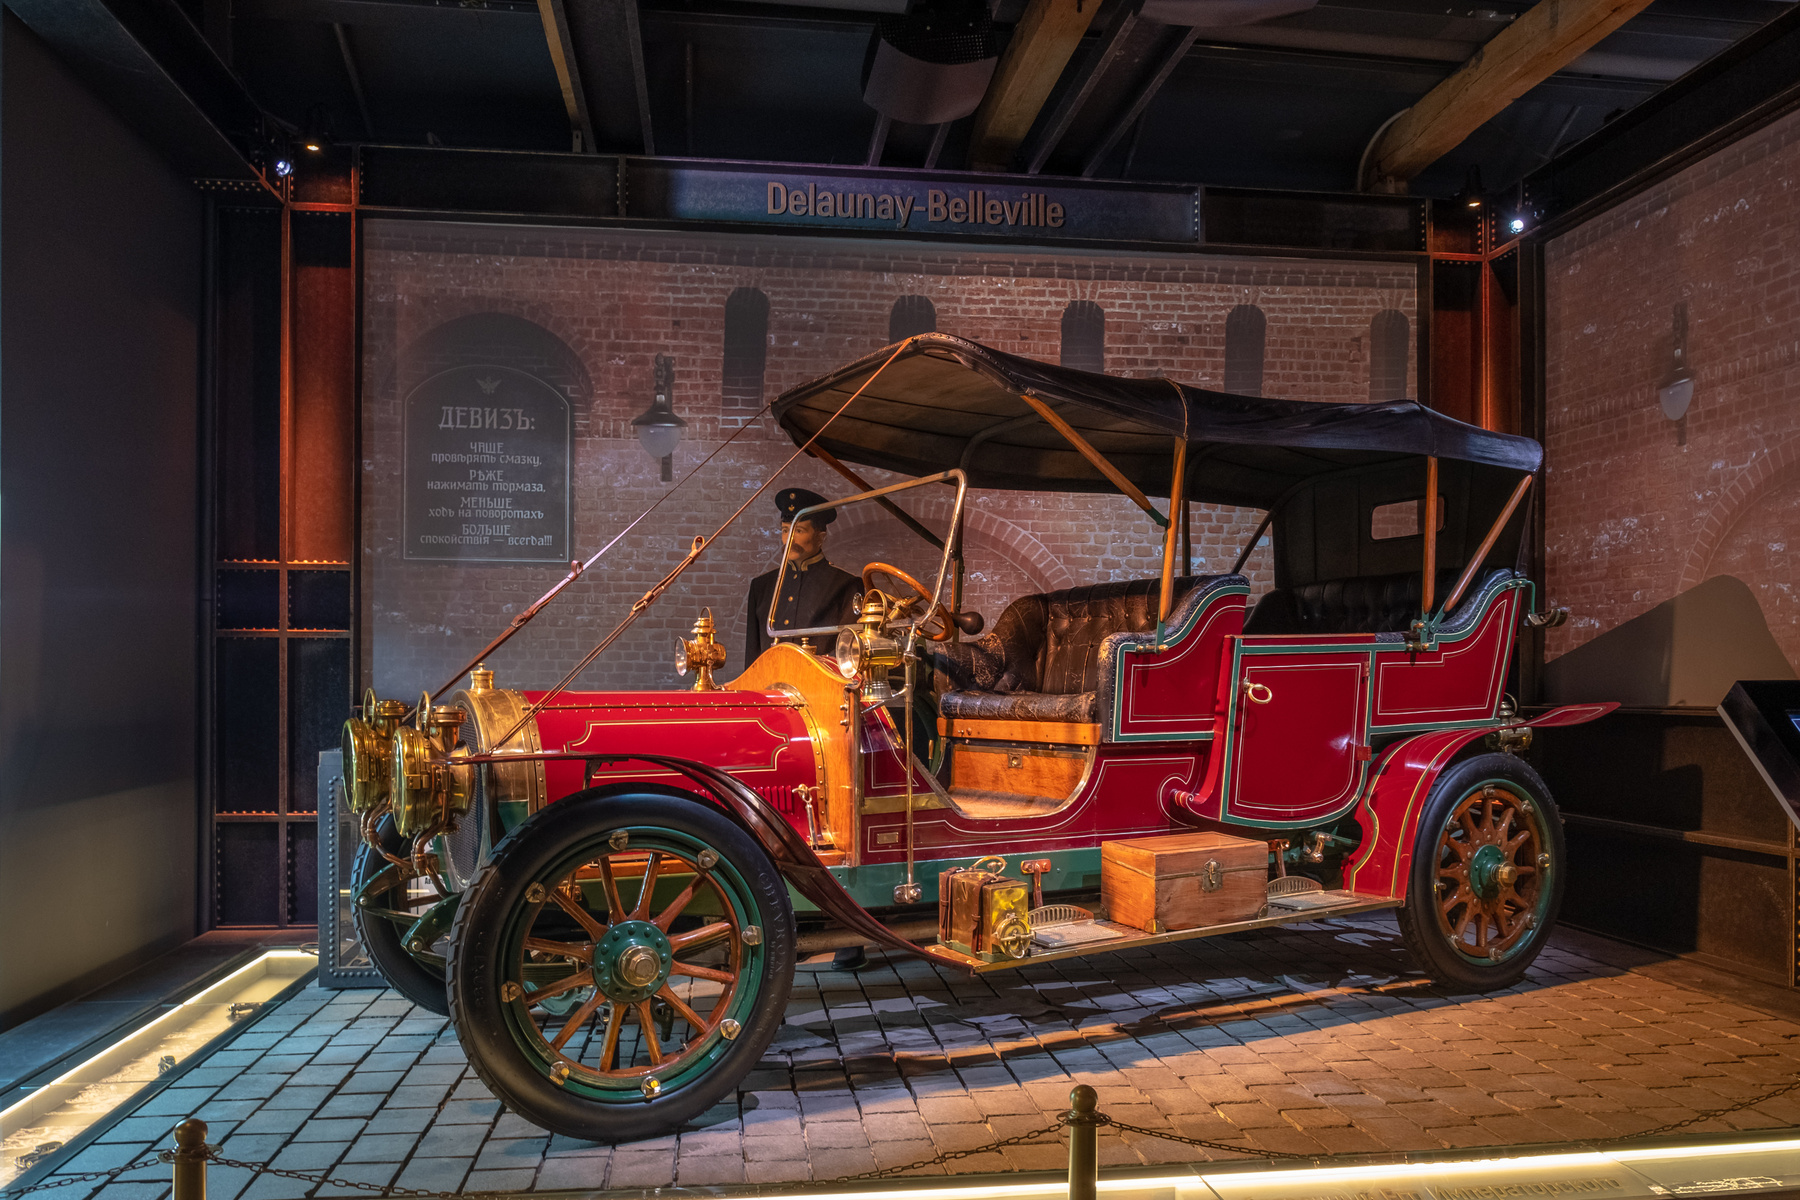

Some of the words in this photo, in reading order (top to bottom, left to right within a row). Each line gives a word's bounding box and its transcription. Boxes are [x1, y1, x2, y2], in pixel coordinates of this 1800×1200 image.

[767, 181, 1066, 229] Delaunay-Belleville
[438, 406, 535, 430] ДЕВИЗЪ:
[427, 480, 489, 491] нажимать
[460, 497, 513, 509] МЕНЬШЕ
[458, 509, 472, 518] на
[475, 509, 544, 520] поворотахъ
[462, 523, 511, 536] БОЛЬШЕ
[508, 535, 552, 546] всегда!!!
[1425, 1178, 1622, 1200] Императорского
